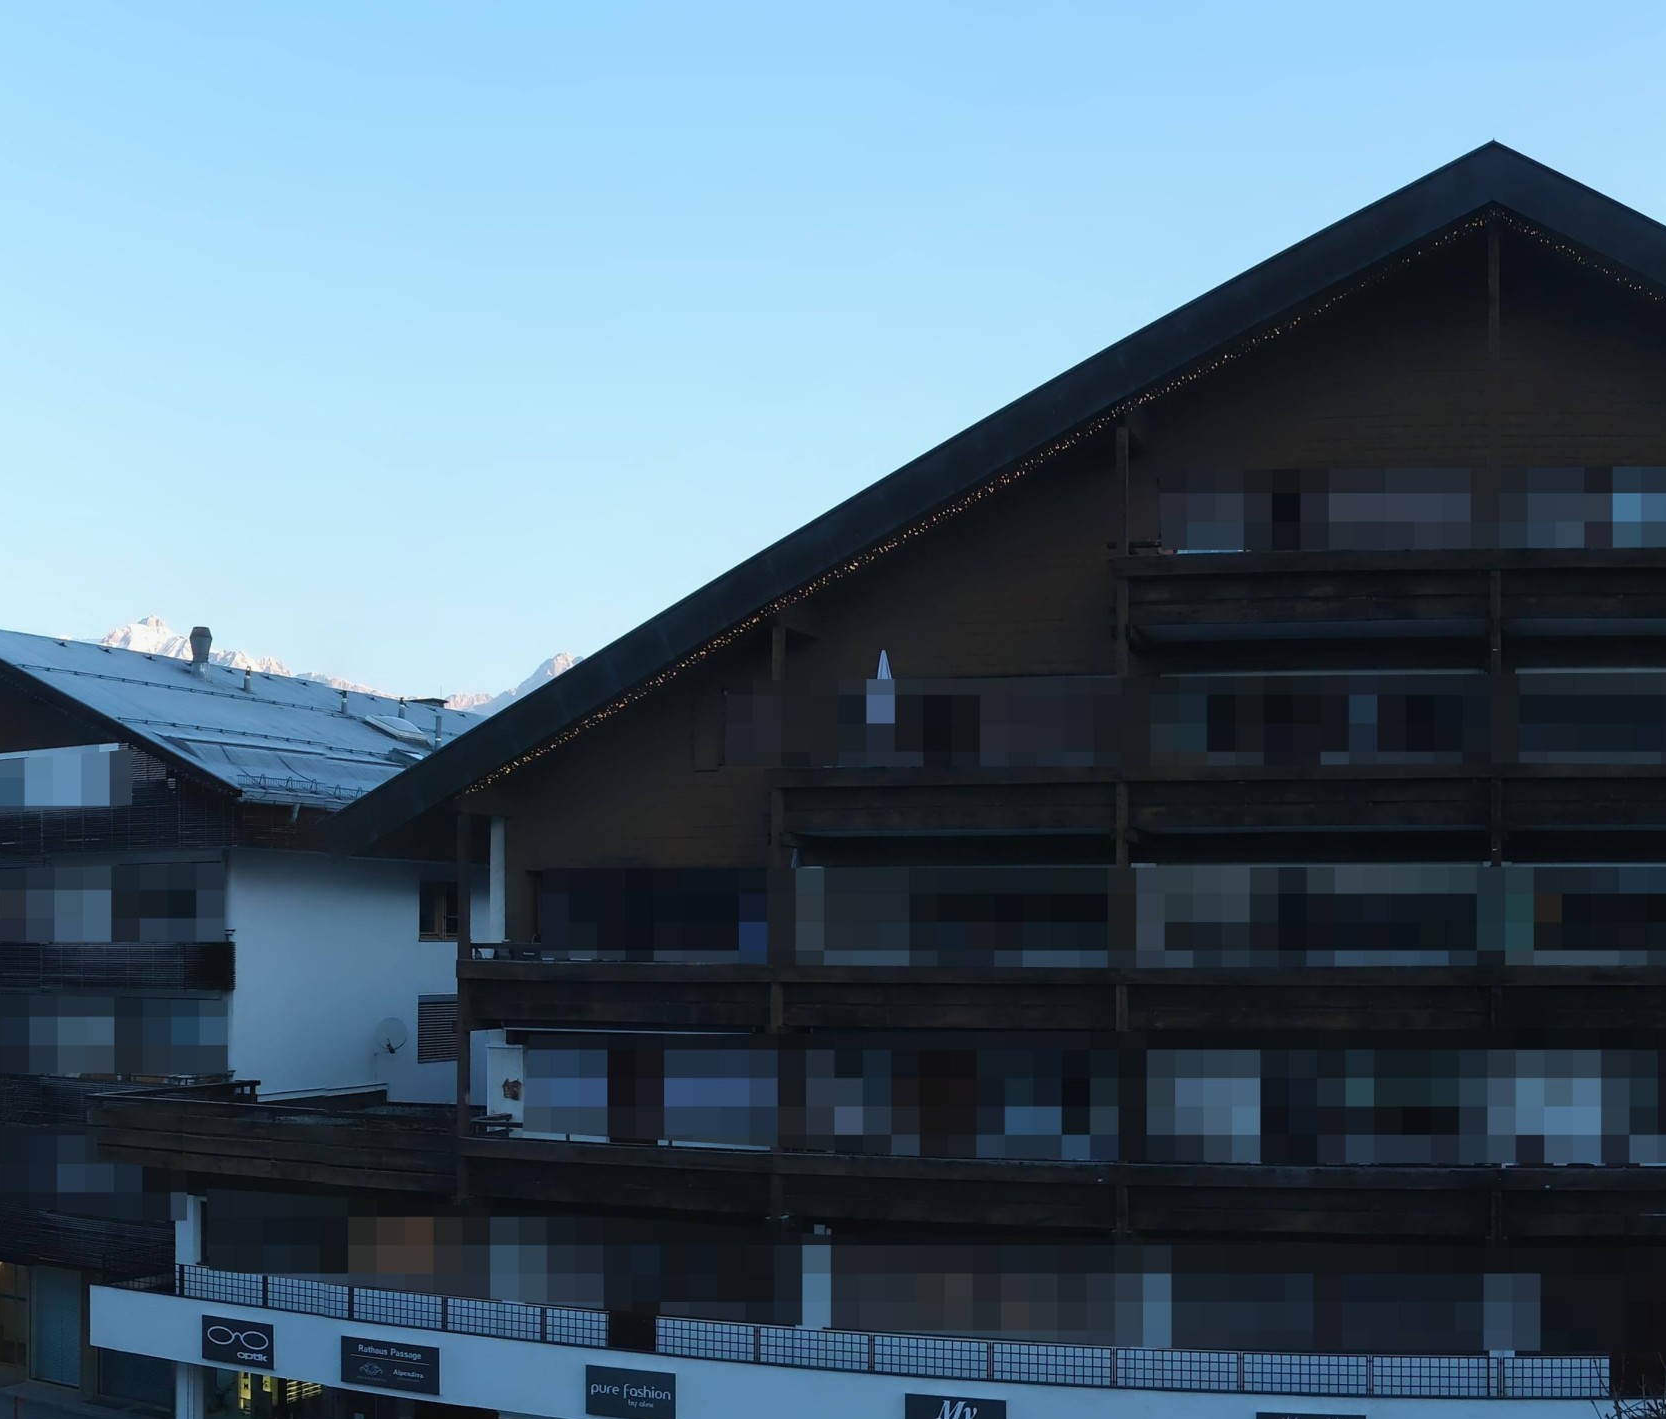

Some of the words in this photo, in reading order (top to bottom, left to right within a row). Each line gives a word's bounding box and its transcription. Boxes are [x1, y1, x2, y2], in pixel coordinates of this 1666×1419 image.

[236, 1351, 268, 1363] optik
[358, 1344, 388, 1356] Rathaus
[390, 1348, 422, 1361] Passage
[590, 1383, 620, 1396] pure
[623, 1383, 671, 1401] fashion
